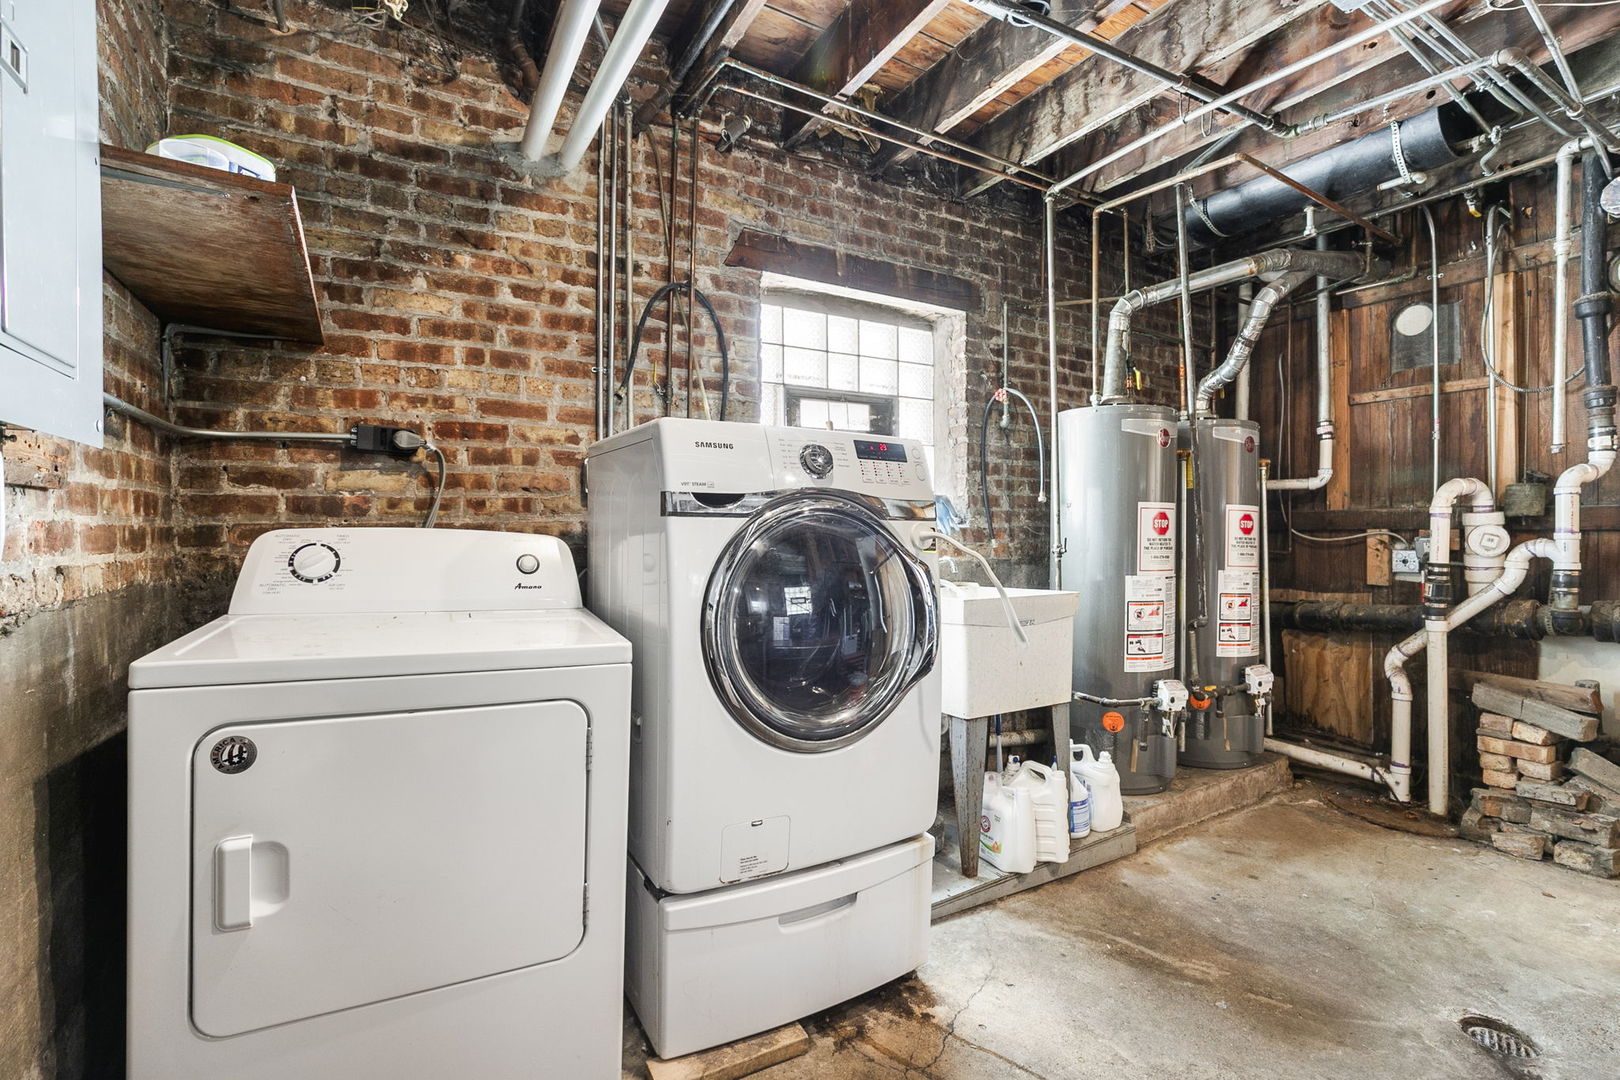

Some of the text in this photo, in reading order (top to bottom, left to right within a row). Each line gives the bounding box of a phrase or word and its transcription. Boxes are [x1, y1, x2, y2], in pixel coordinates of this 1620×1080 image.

[695, 441, 734, 450] SAMSUNG
[1153, 519, 1169, 528] STOP
[1240, 520, 1253, 529] STOP
[514, 582, 543, 590] Amana
[212, 737, 237, 770] AMERICA
